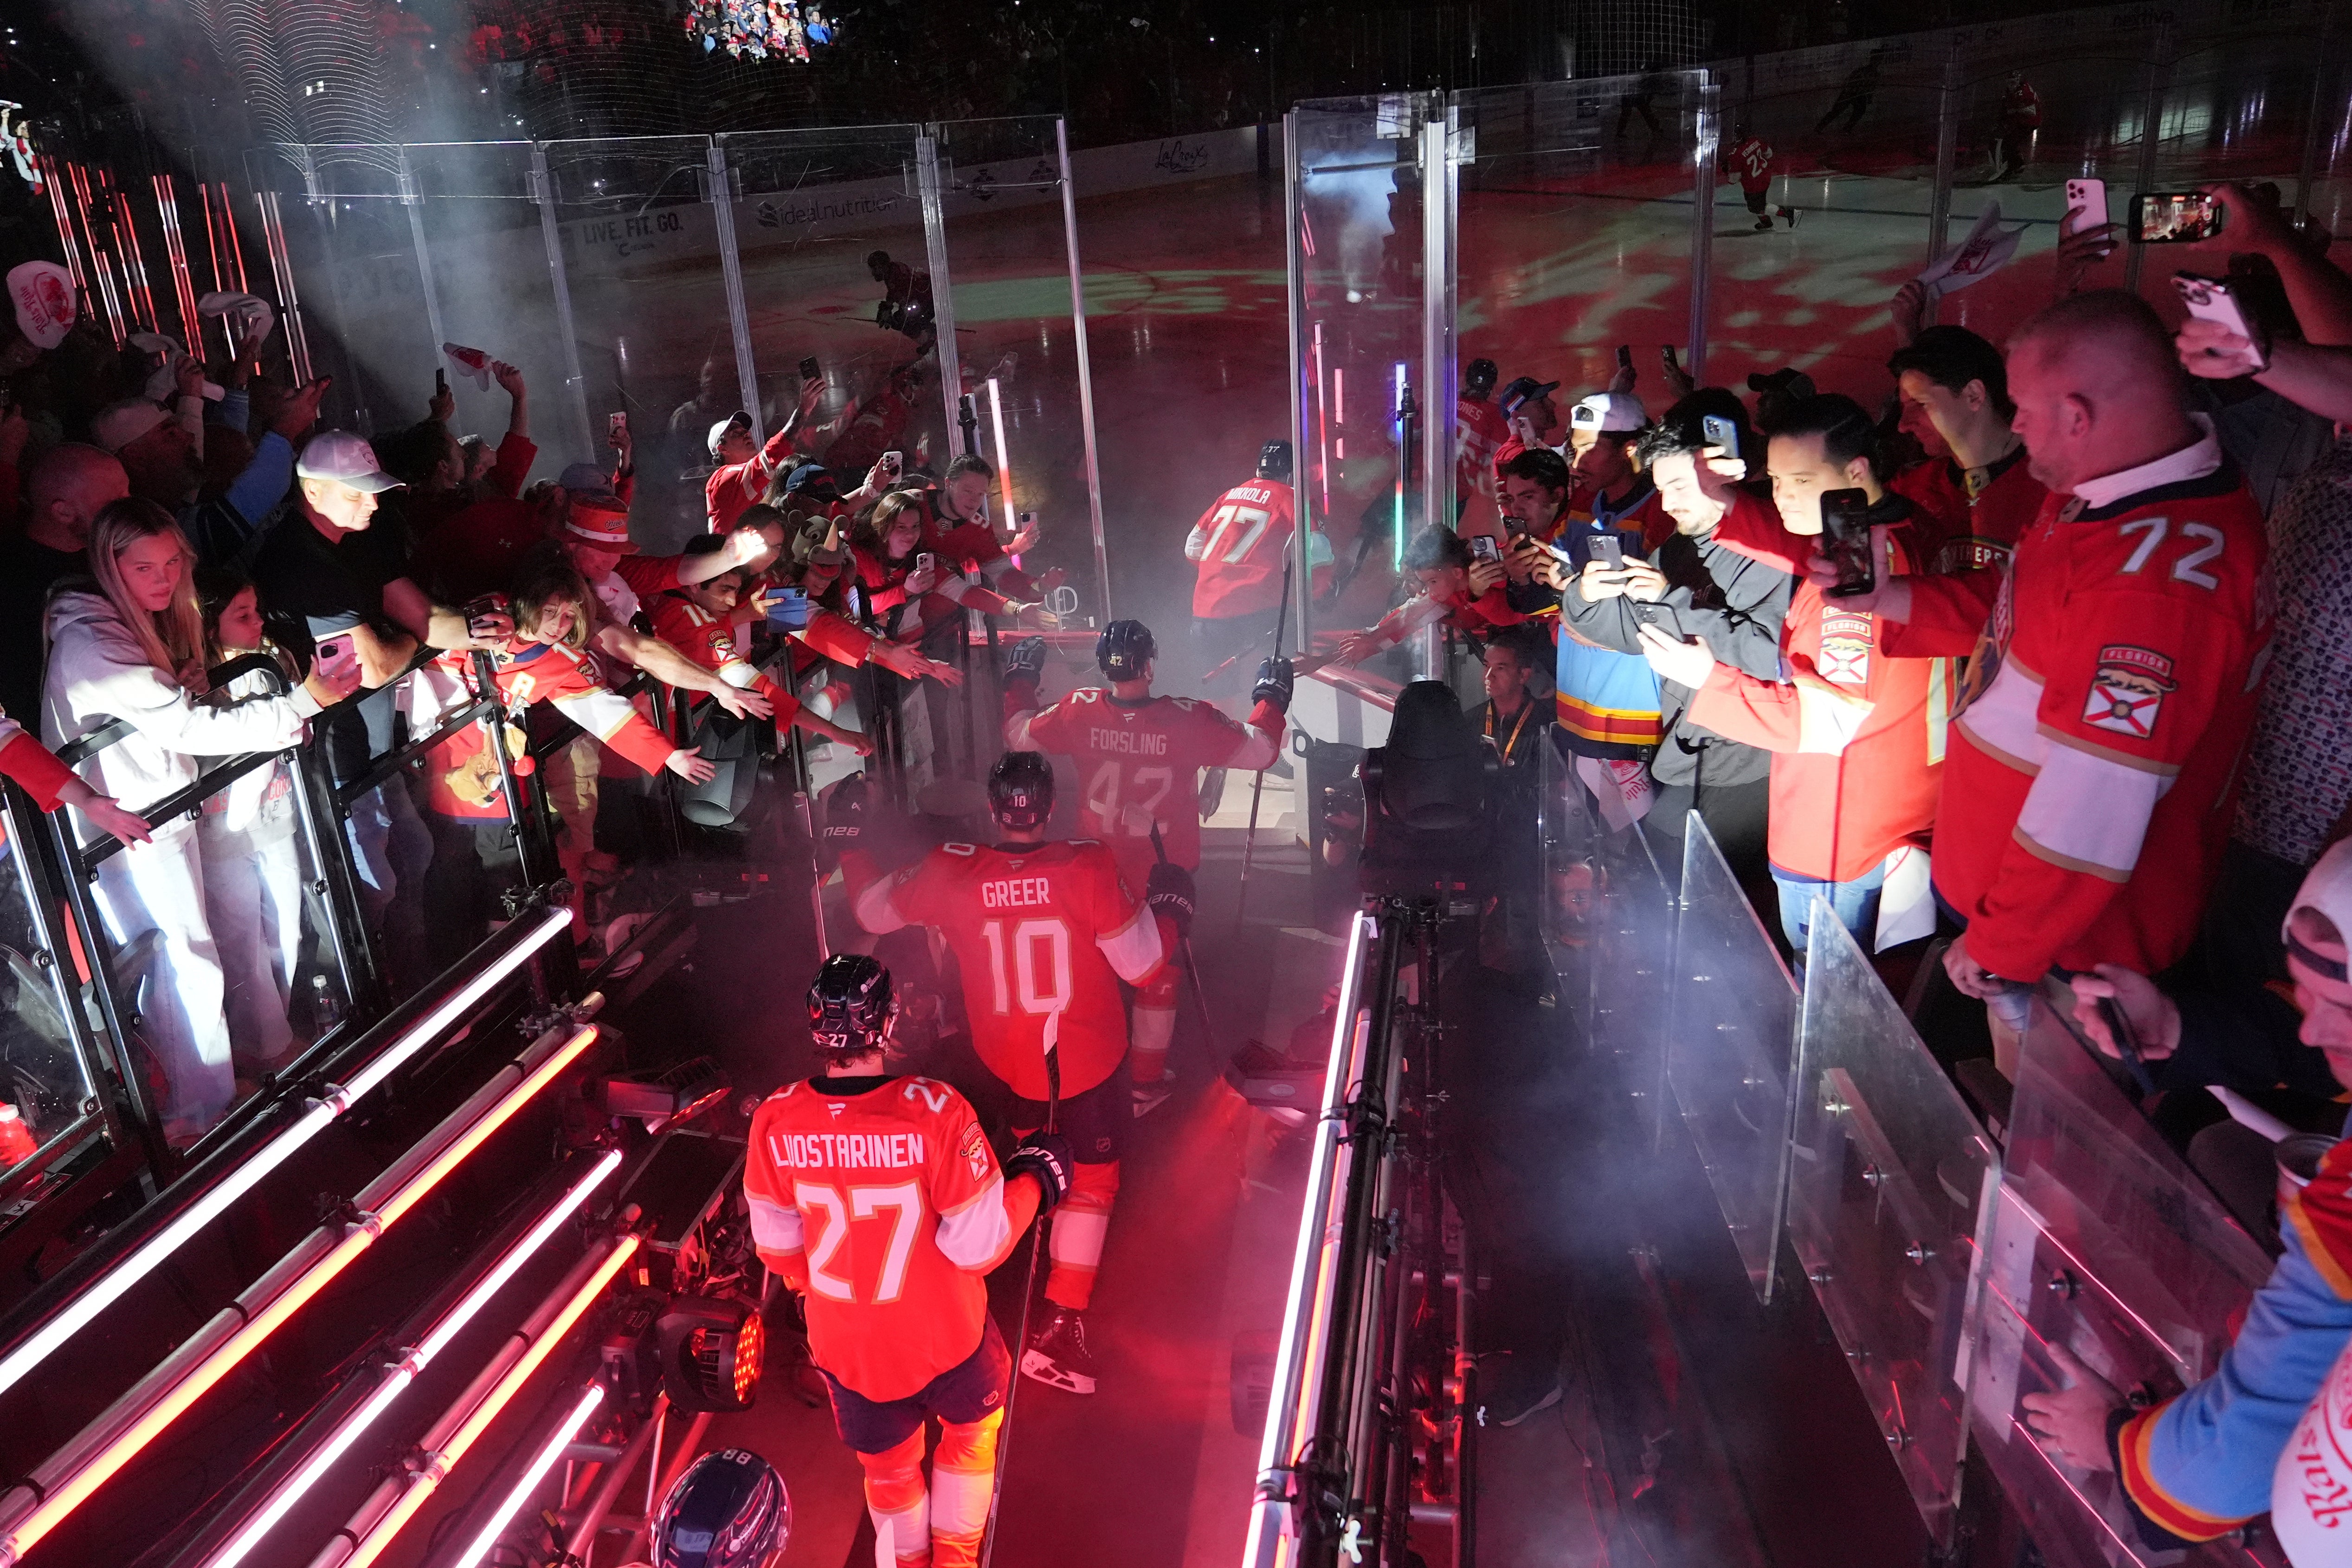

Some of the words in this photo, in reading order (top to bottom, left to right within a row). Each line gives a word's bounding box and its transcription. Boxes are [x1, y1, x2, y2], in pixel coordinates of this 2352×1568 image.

[1746, 147, 1768, 178] 23
[583, 221, 621, 244] LIVE.
[625, 216, 653, 237] FIT.
[657, 213, 683, 232] GO.
[1225, 488, 1271, 504] MIKKOLA
[1199, 505, 1271, 565] 77
[2118, 516, 2226, 591] 72
[1826, 622, 1867, 632] FLORIDA
[1110, 656, 1123, 666] 42
[2108, 650, 2165, 669] FLORIDA
[1090, 727, 1167, 755] FORSLING
[1014, 795, 1026, 807] 10
[1089, 761, 1174, 837] 42
[981, 877, 1051, 908] GREER
[979, 916, 1074, 1018] 10
[829, 1034, 848, 1048] 27
[769, 1133, 924, 1168] LUOSTARINEN
[795, 1178, 925, 1304] 27
[722, 1448, 752, 1465] 88
